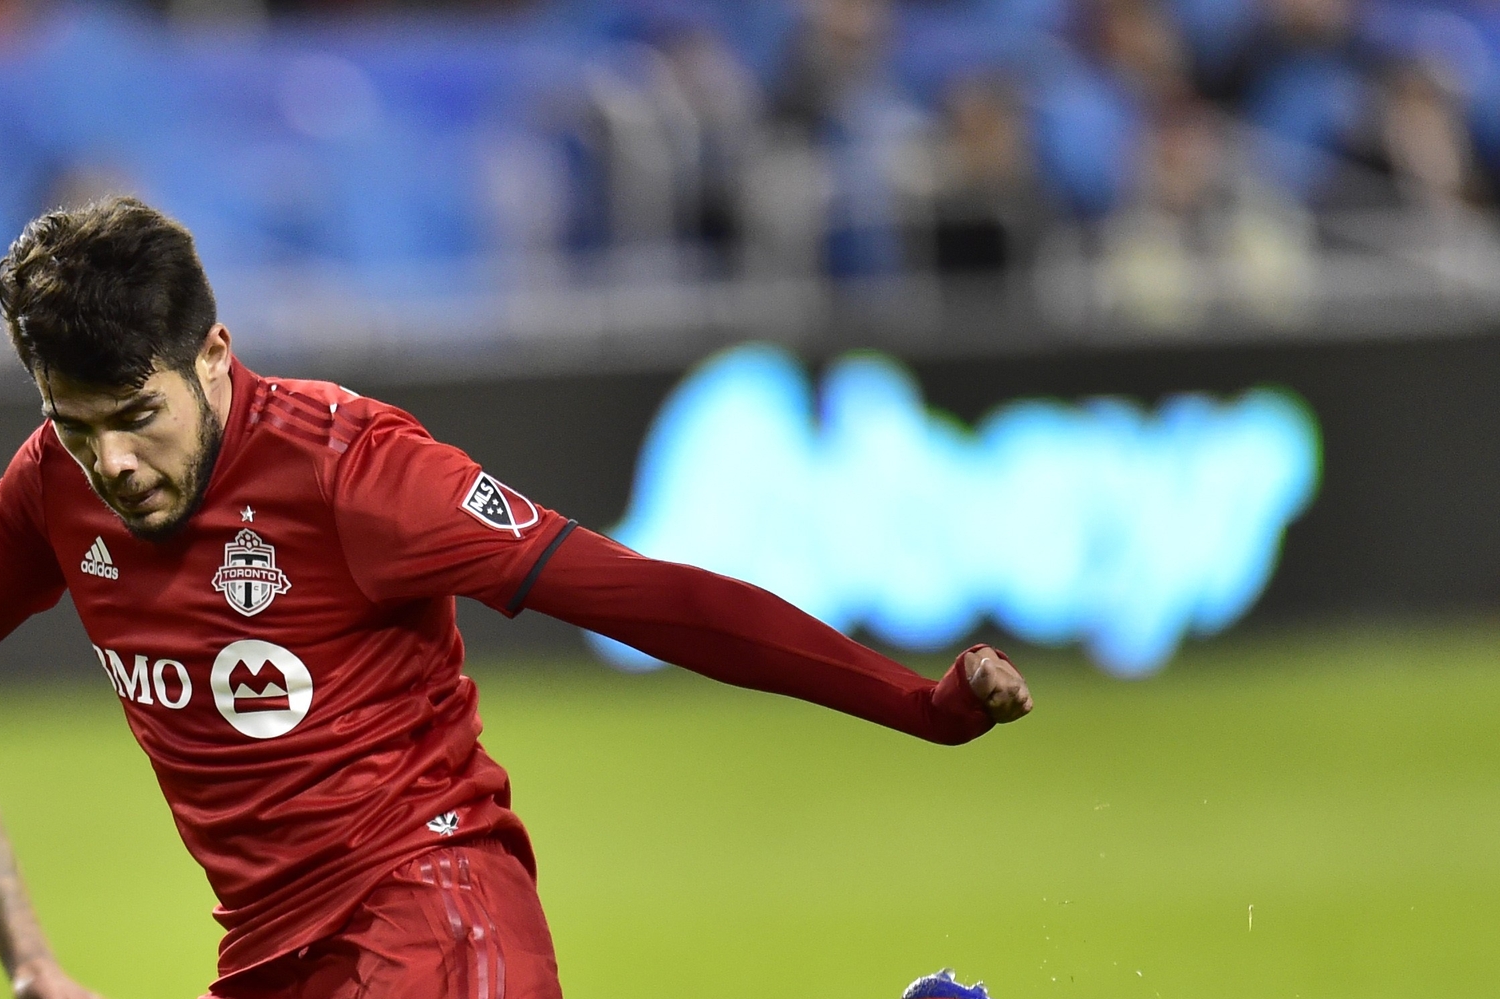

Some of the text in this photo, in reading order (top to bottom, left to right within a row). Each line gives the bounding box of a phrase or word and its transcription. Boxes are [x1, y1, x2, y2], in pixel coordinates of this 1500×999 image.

[469, 482, 495, 513] MLS
[81, 560, 119, 580] adidas
[223, 568, 277, 581] TORONTO
